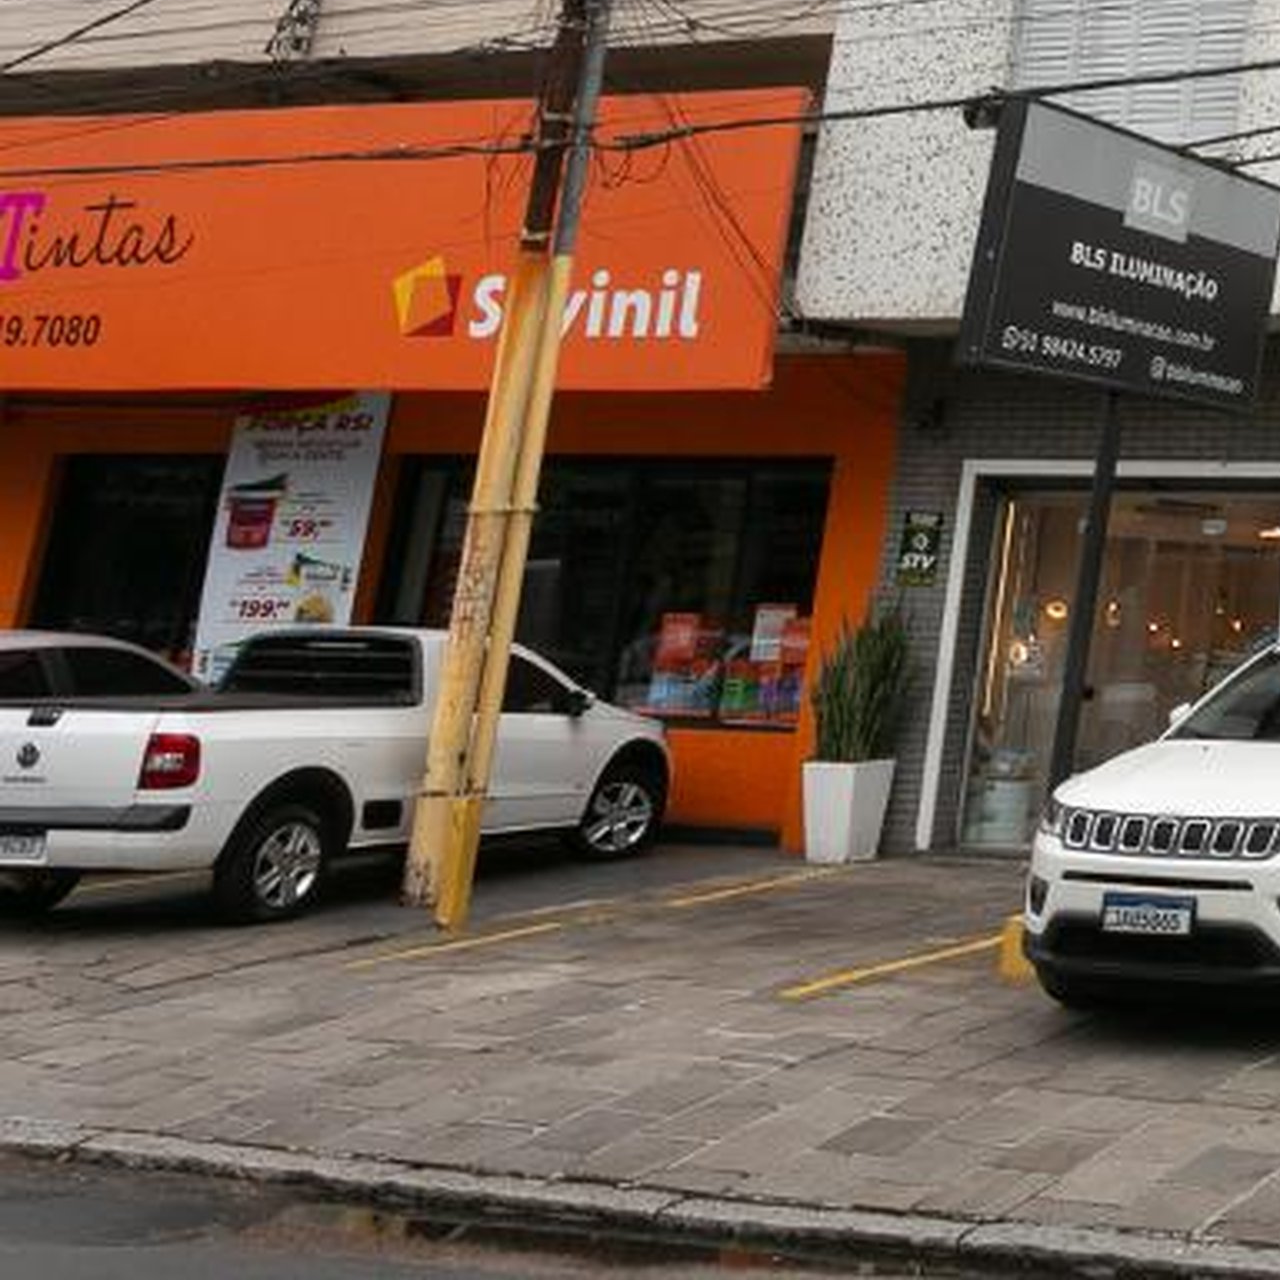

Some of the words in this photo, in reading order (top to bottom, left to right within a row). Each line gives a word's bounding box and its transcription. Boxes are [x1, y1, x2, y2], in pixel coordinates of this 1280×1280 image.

[1133, 180, 1188, 225] BLS
[0, 193, 194, 281] Tintas
[1070, 241, 1107, 270] BLS
[1109, 252, 1218, 299] ILUMINAÇÃO
[0, 314, 102, 347] 9.7080
[901, 552, 936, 569] STV
